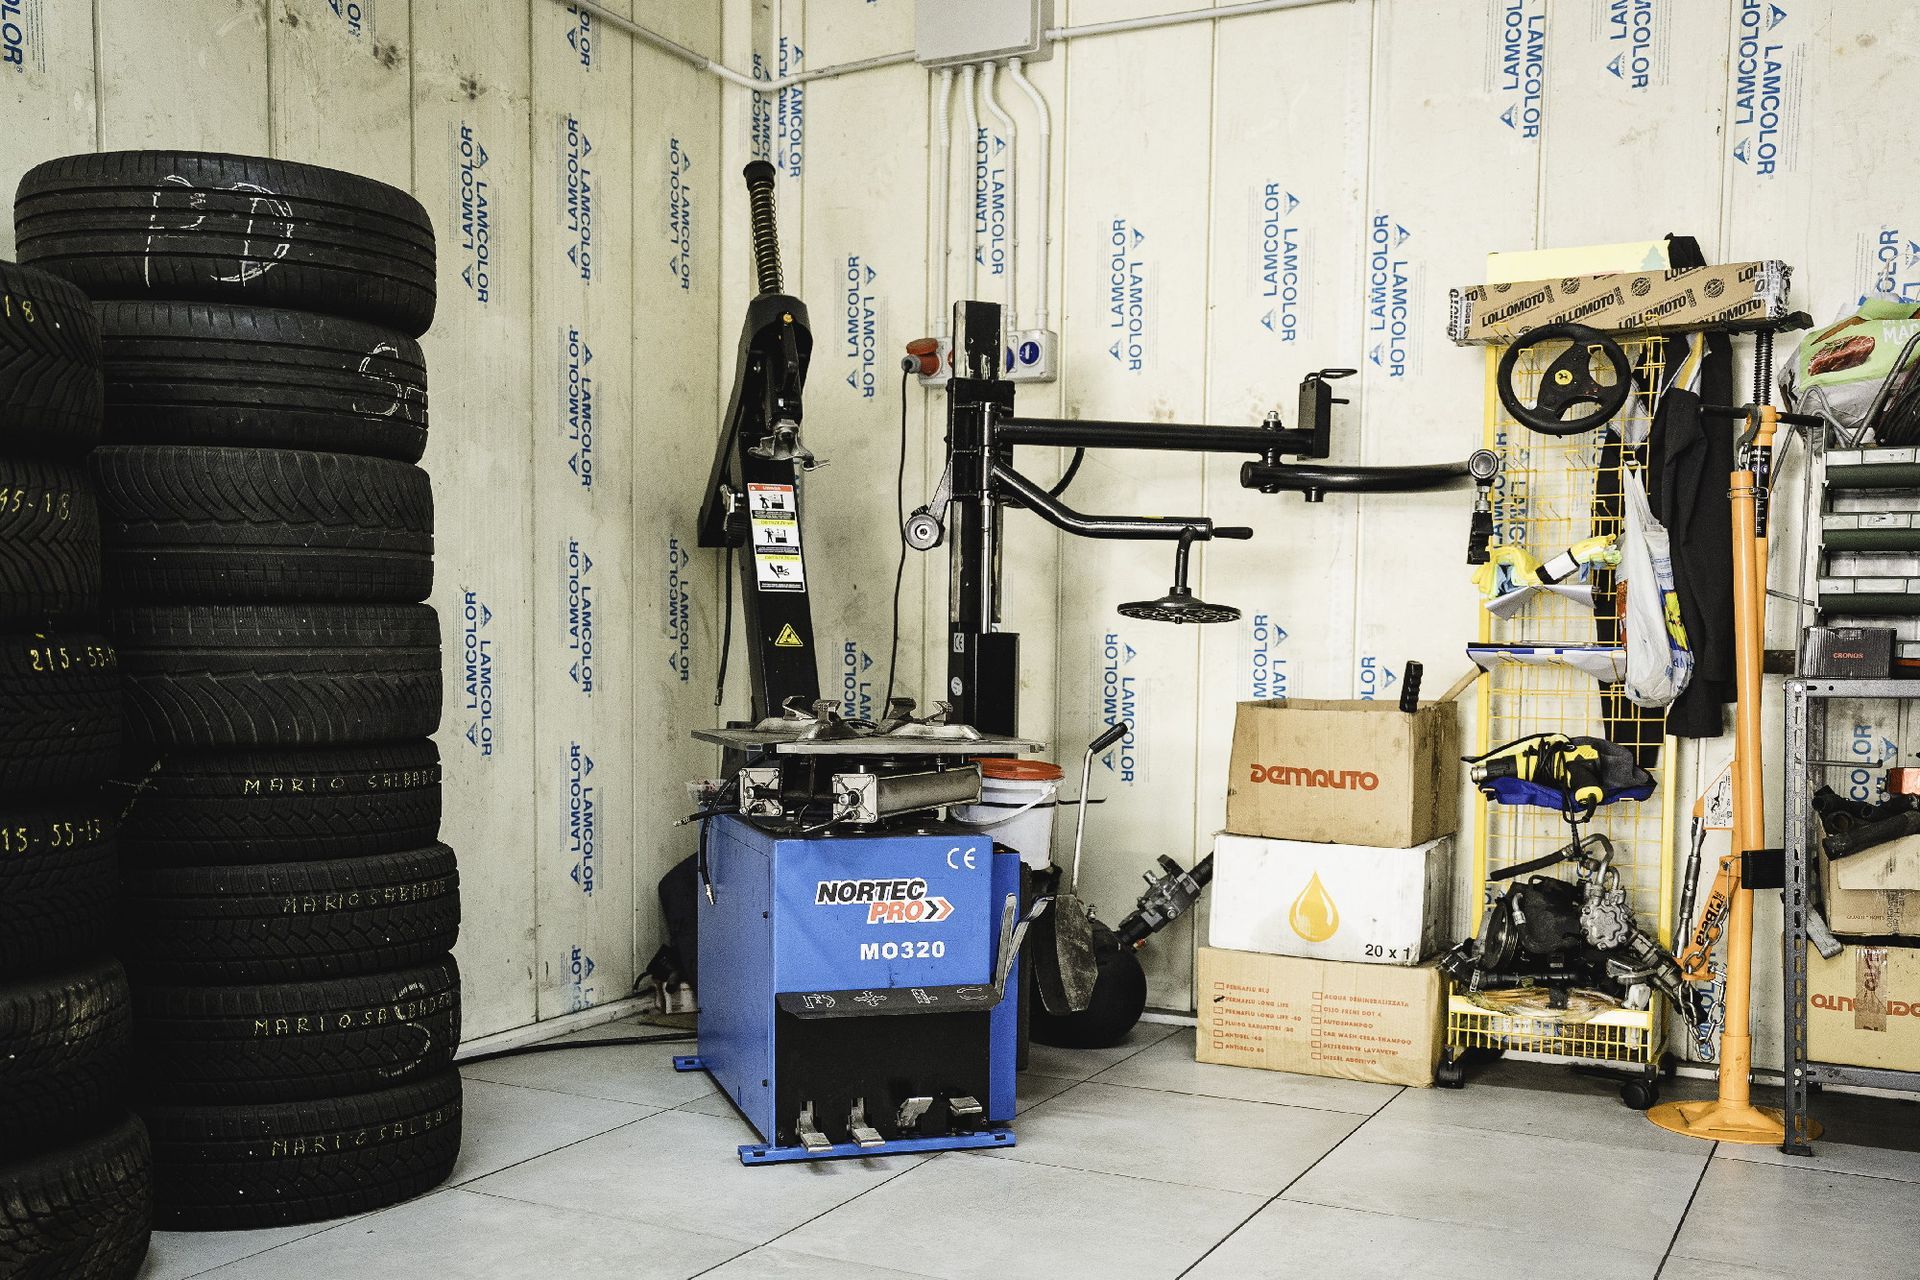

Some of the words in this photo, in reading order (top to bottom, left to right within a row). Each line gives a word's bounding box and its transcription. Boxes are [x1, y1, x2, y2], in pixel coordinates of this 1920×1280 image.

[1522, 15, 1544, 138] LAMCOLOR
[1757, 45, 1784, 176] LAMCOLOR
[568, 119, 578, 231] LAMCOLOR
[790, 87, 802, 178] AMCOLOR
[461, 126, 474, 250] LAMCOLOR
[476, 181, 489, 303] LAMCOLOR
[581, 168, 591, 281] LAMCOLOR
[670, 138, 680, 244] LAMCOLOR
[681, 185, 690, 290] LAMCOLOR
[992, 169, 1004, 275] LAMCOLOR
[1264, 182, 1279, 297] LAMCOLOR
[848, 256, 860, 358] LAMCOLOR
[1112, 218, 1126, 328] LAMCOLOR
[1129, 262, 1144, 370] LAMCOLOR
[1282, 228, 1298, 342] LAMCOLOR
[1371, 214, 1389, 331] LAMCOLOR
[1390, 260, 1408, 378] LAMCOLOR
[1482, 291, 1546, 328] LOLLOMOTO
[569, 330, 579, 440] LAMCOLOR
[864, 296, 875, 398] LAMCOLOR
[582, 378, 592, 487] LAMCOLOR
[569, 541, 579, 649] LAMCOLOR
[582, 586, 592, 692] LAMCOLOR
[670, 538, 679, 640] LAMCOLOR
[680, 580, 689, 682] LAMCOLOR
[466, 592, 478, 709] LAMCOLOR
[480, 640, 492, 757] LAMCOLOR
[1104, 634, 1118, 729] AMCOLOR
[571, 744, 581, 852] LAMCOLOR
[584, 786, 594, 894] LAMCOLOR
[817, 879, 926, 904] NORTEC
[870, 900, 924, 922] PRO
[860, 940, 946, 961] MO320
[1365, 944, 1384, 958] 20
[1388, 948, 1397, 959] x
